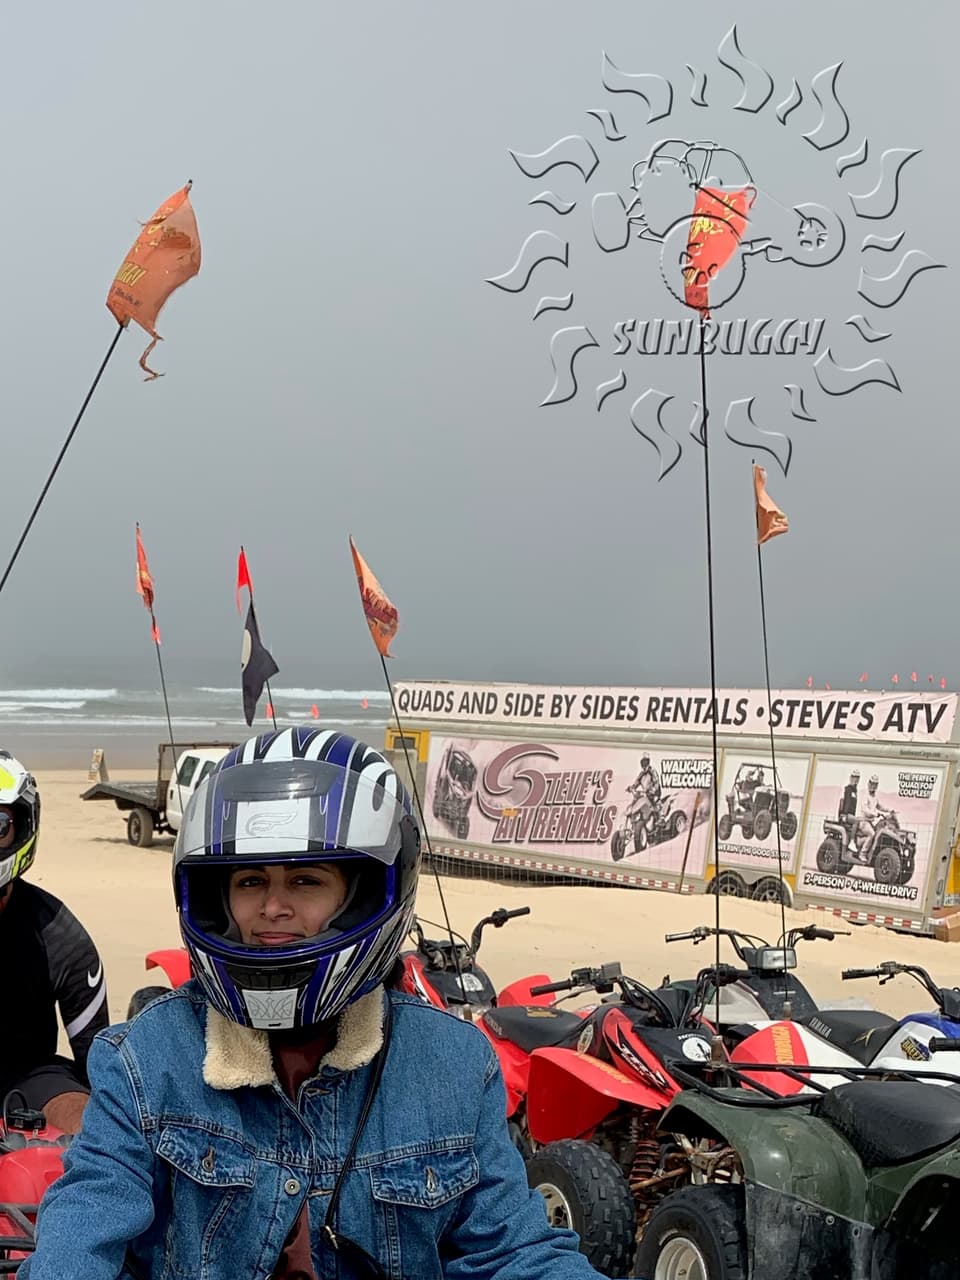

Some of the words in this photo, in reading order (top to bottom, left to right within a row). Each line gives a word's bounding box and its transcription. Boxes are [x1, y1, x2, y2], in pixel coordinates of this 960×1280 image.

[398, 688, 454, 713] QUADS
[458, 690, 498, 715] AND
[502, 692, 545, 718] SIDE
[549, 693, 577, 719] BY
[580, 694, 640, 722] SIDES
[645, 695, 749, 727] RENTALS
[769, 698, 876, 732] STEVE'S
[882, 702, 949, 734] ATV
[661, 758, 714, 774] WALK-UPS
[661, 772, 712, 789] WELCOME
[492, 806, 534, 843] ATV
[529, 805, 618, 844] RENTALS
[804, 872, 845, 890] 2-PERSON
[889, 884, 918, 900] DRIVE
